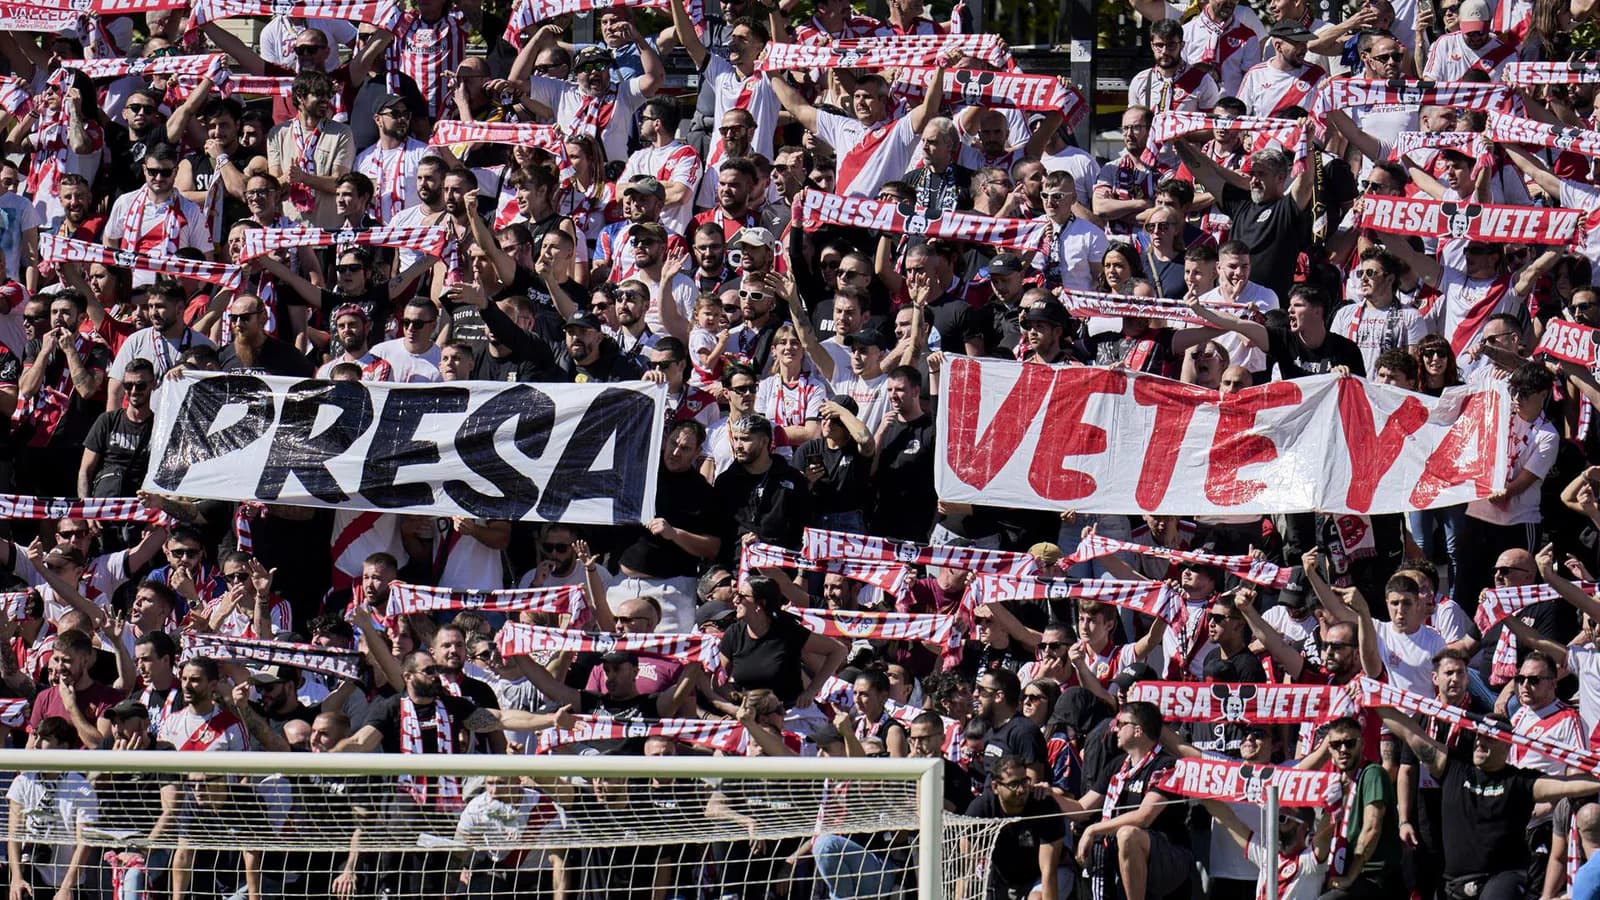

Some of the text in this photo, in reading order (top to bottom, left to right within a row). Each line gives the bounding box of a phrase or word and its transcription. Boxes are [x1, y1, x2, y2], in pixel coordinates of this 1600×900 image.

[515, 0, 577, 29] RESA
[768, 45, 832, 68] RESA
[1508, 61, 1568, 83] RESA
[898, 67, 954, 99] RESA
[992, 75, 1051, 106] VETE
[1314, 80, 1386, 117] RESA
[803, 189, 897, 230] PRESA
[938, 211, 1006, 243] VETE
[1363, 198, 1579, 240] PRESA VETE YA
[40, 232, 104, 262] RESA
[246, 228, 321, 258] RESA
[1540, 322, 1591, 361] RESA
[152, 375, 655, 525] PRESA
[947, 358, 1500, 512] VETE YA
[808, 528, 883, 559] RESA
[387, 584, 451, 615] RESA
[1257, 686, 1323, 718] VETE
[1166, 759, 1237, 797] PRESA
